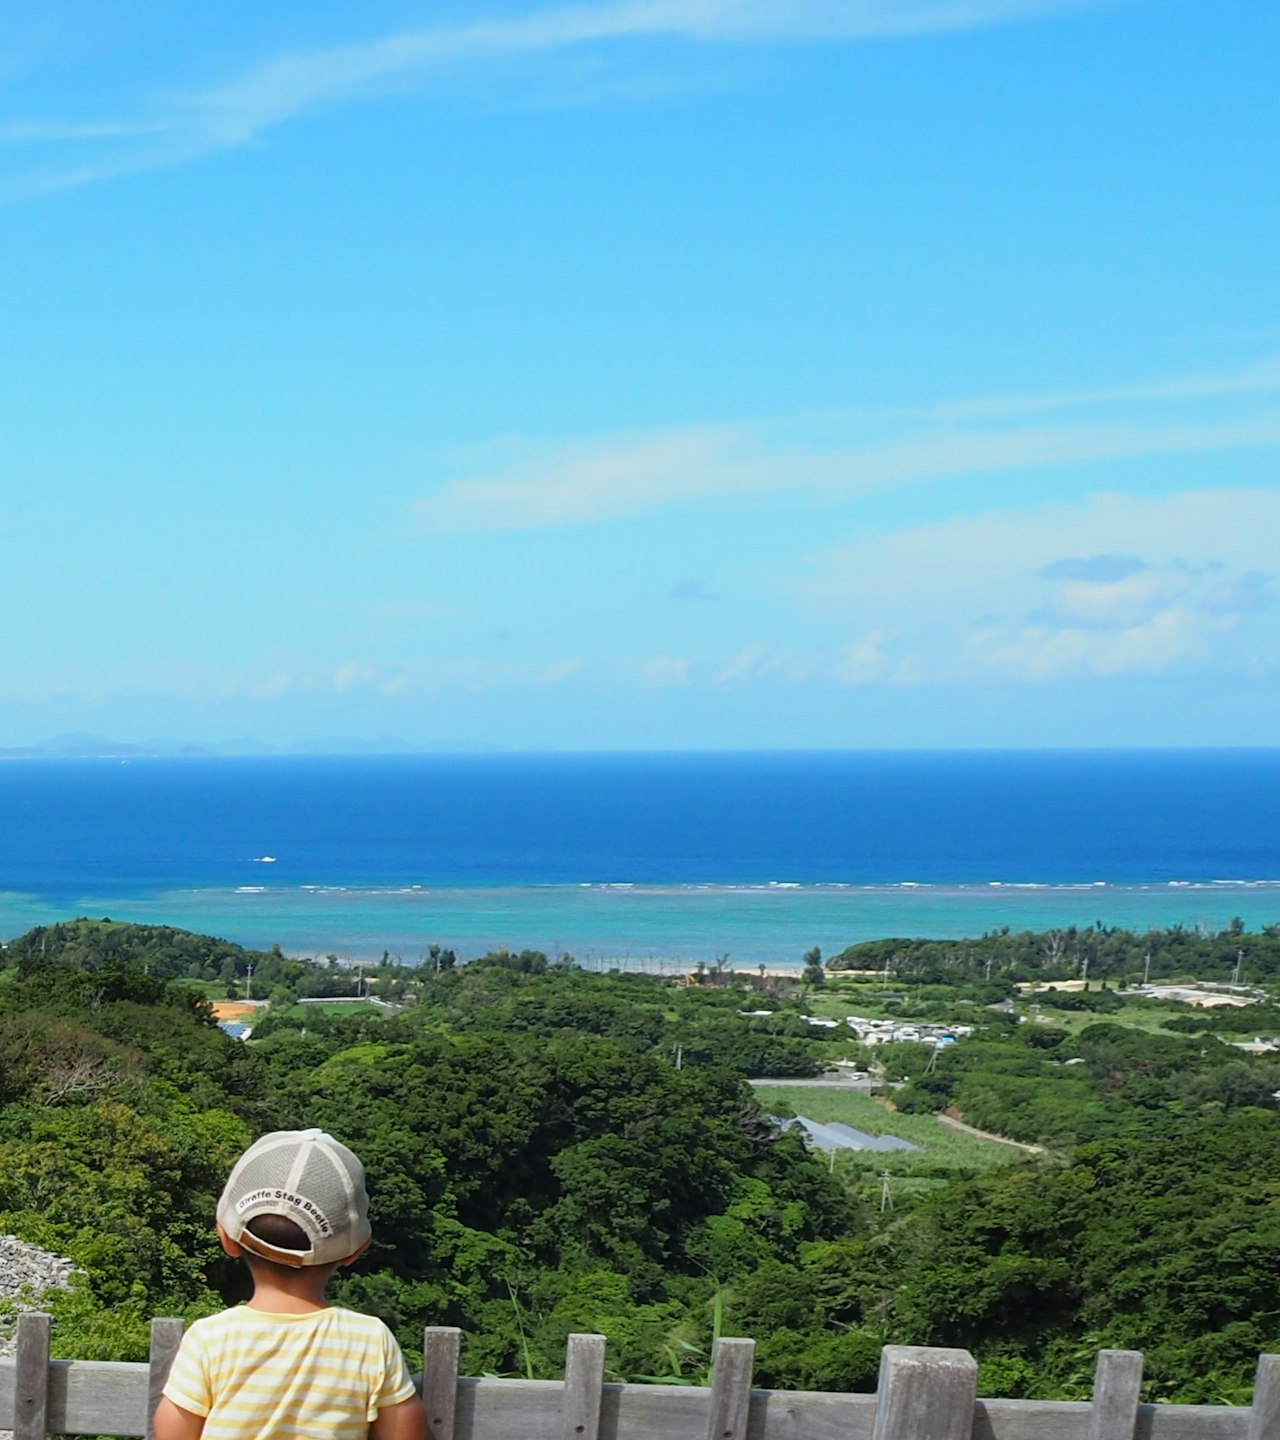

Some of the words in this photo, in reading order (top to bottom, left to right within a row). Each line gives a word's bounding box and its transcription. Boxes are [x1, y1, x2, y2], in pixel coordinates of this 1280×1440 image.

[239, 1190, 272, 1209] Giraffe
[274, 1190, 302, 1206] Stag
[303, 1202, 330, 1233] Beetle
